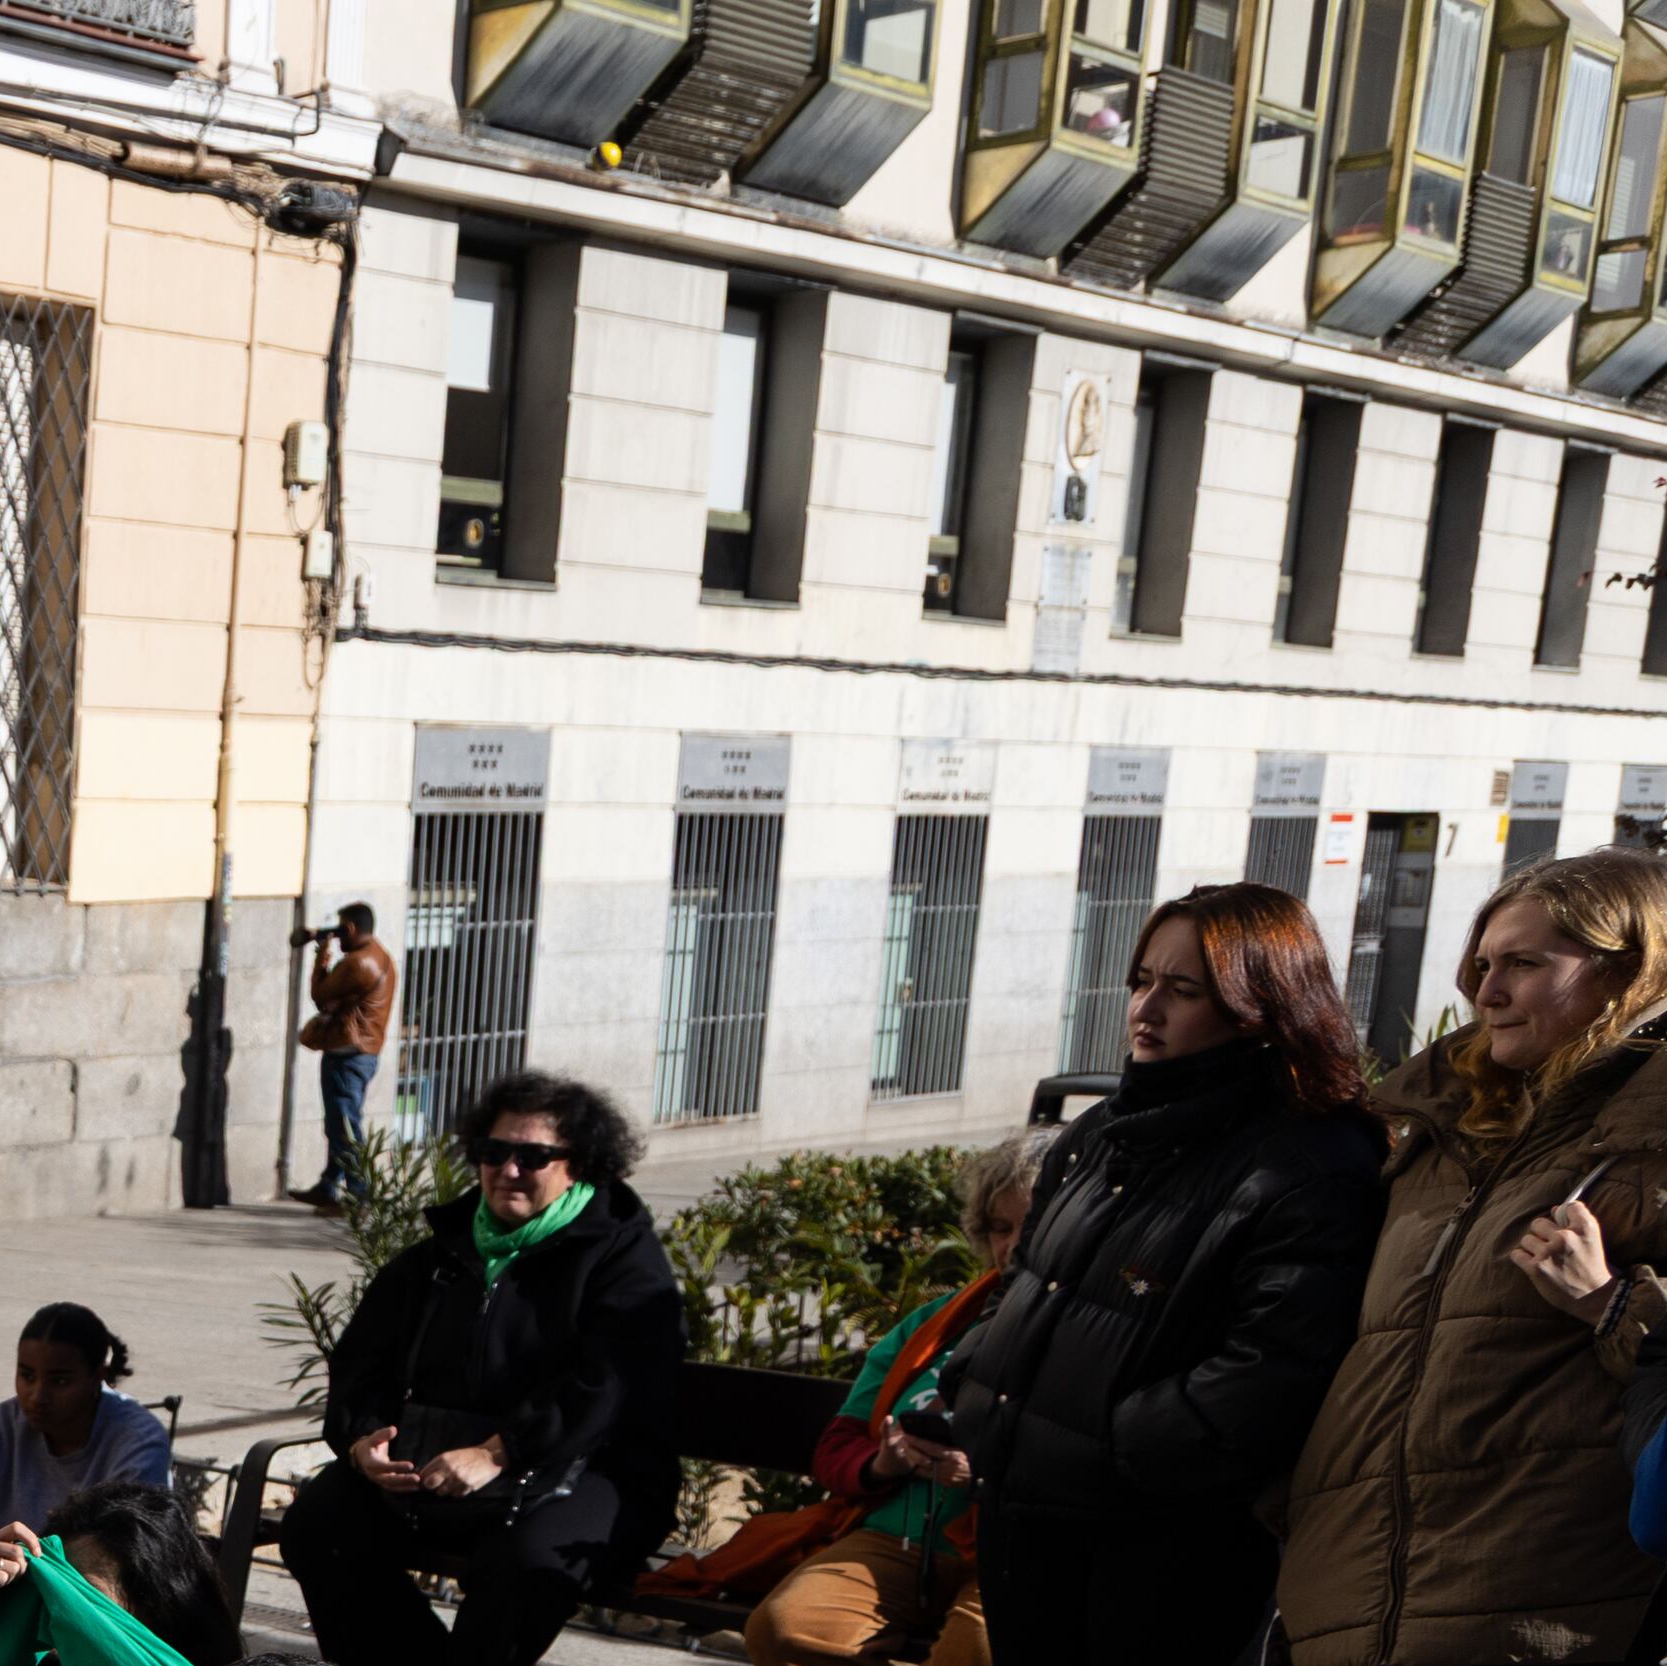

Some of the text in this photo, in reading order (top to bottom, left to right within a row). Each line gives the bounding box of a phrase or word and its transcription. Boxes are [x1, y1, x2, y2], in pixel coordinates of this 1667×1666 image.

[420, 782, 544, 799] Comunidad de Madrid
[1444, 822, 1459, 857] 7
